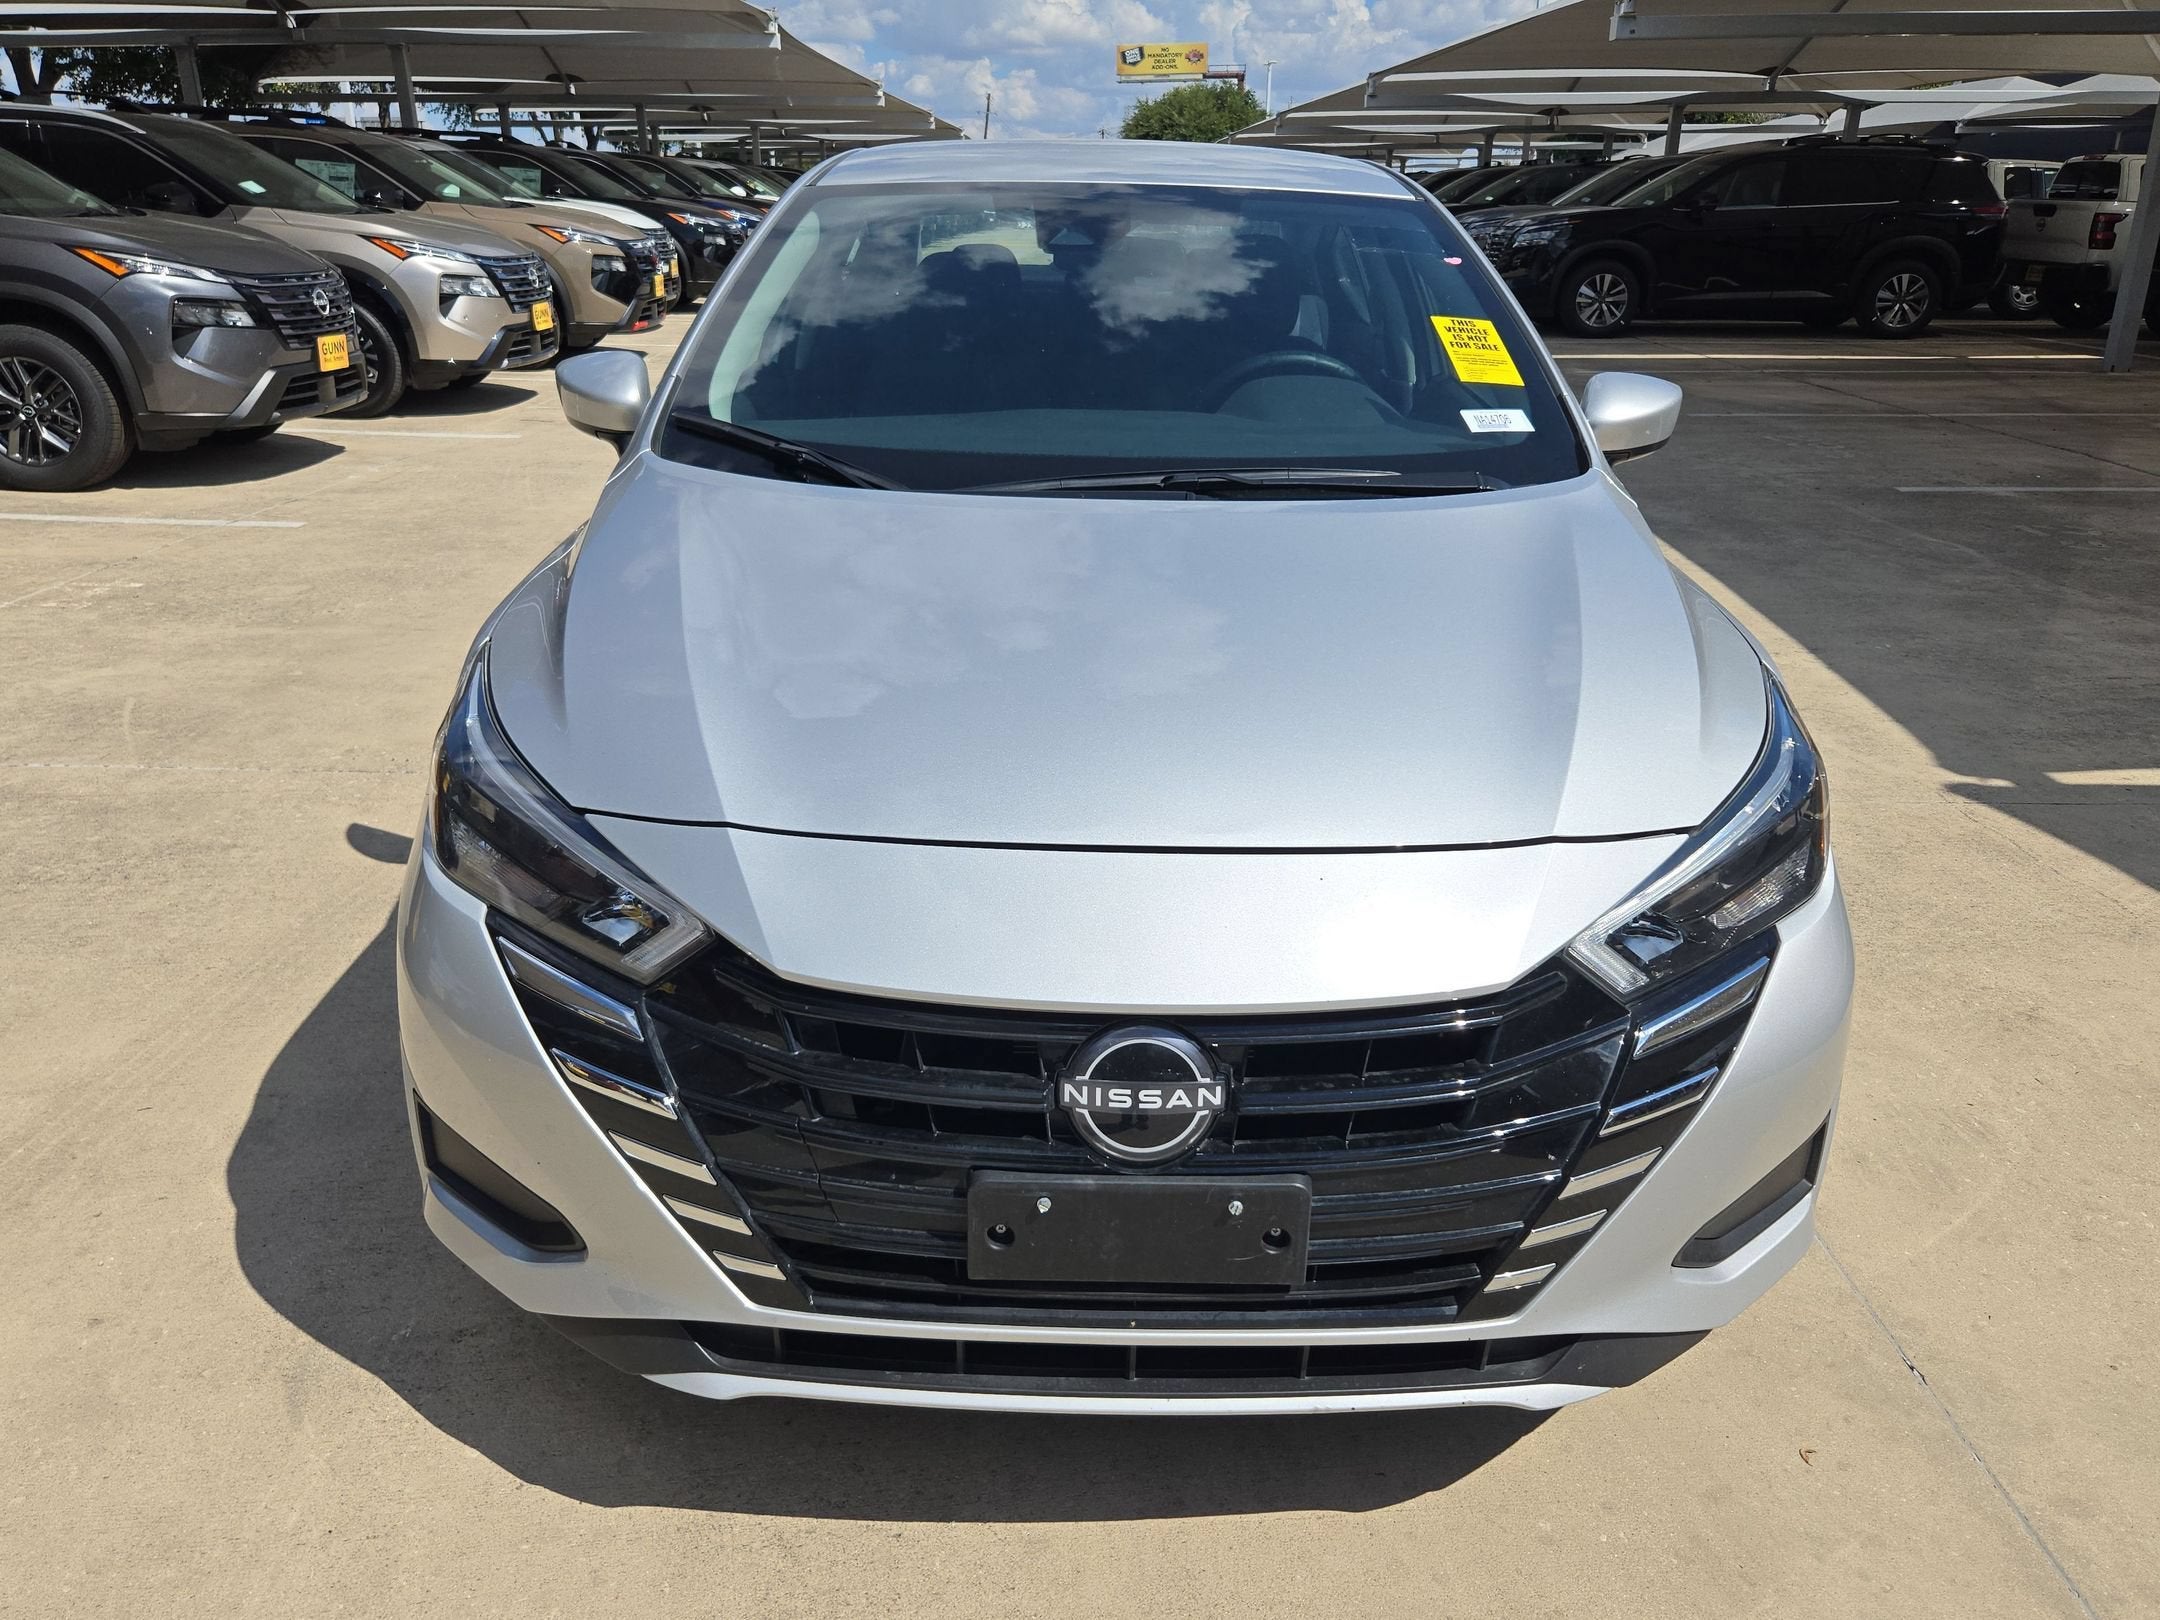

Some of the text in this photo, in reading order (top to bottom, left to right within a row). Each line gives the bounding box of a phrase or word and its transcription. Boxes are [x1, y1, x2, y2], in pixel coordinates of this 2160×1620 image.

[1450, 319, 1476, 327] THIS
[1444, 326, 1490, 336] VEHICLE
[1452, 333, 1488, 343] IS NOT
[322, 339, 345, 355] GUNN
[1449, 341, 1500, 352] FOR SALE
[1064, 1083, 1221, 1109] NISSAN
